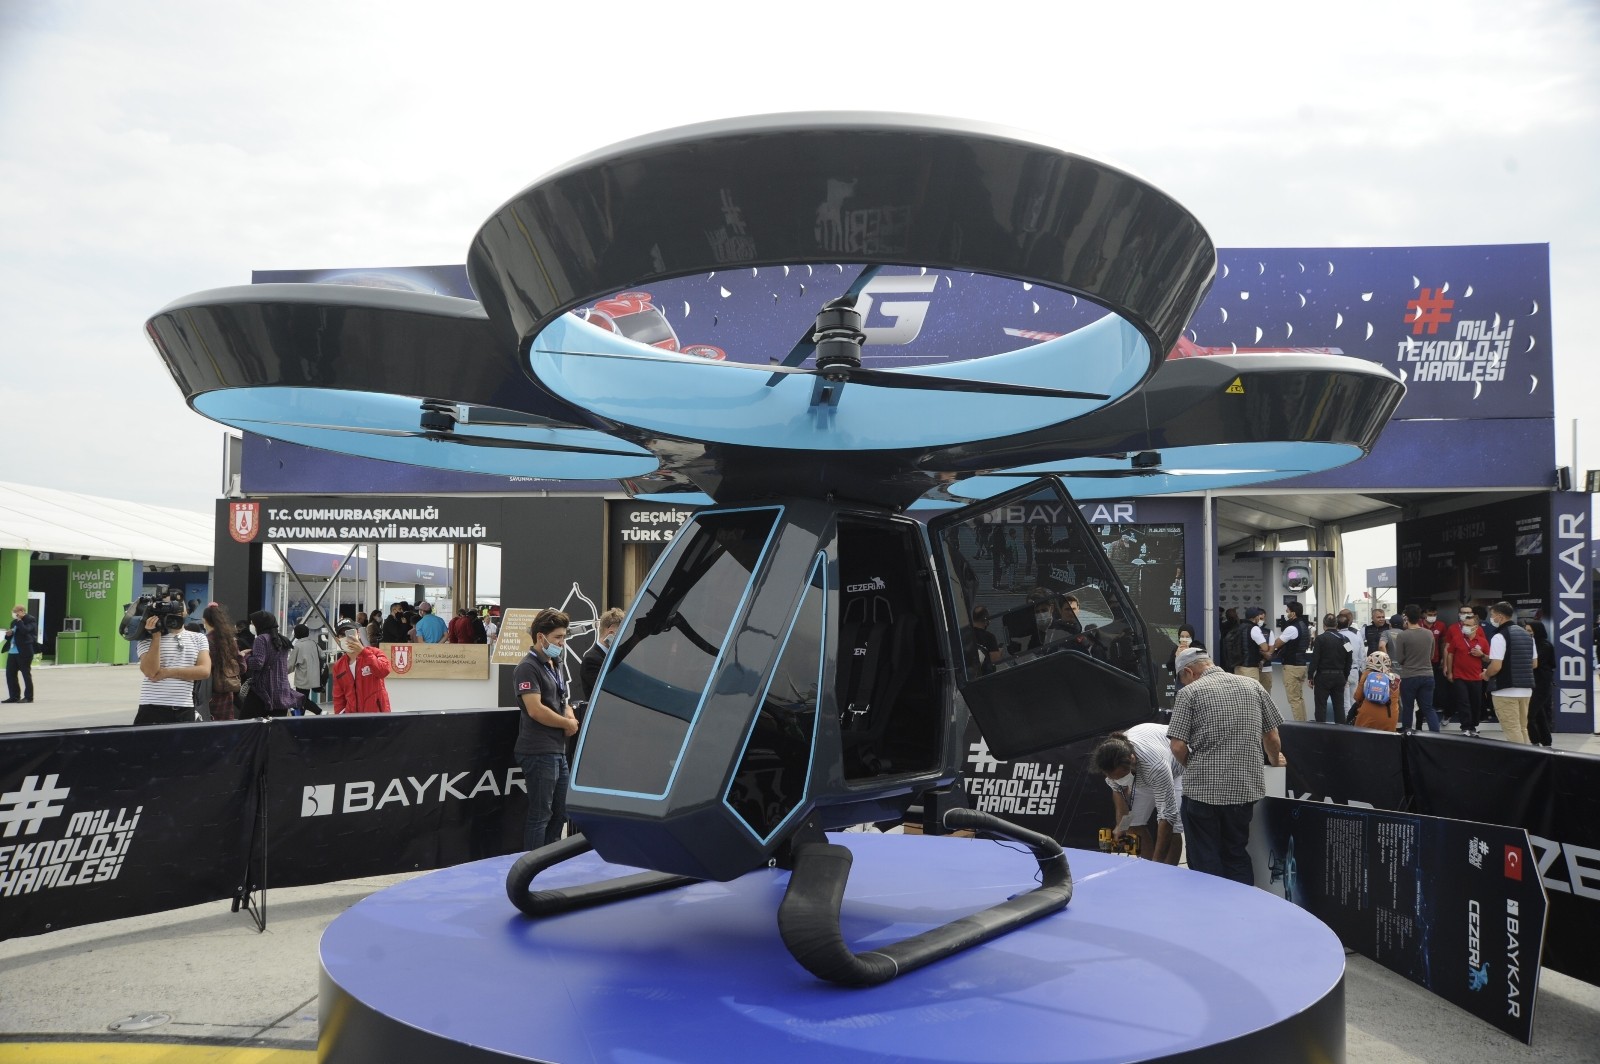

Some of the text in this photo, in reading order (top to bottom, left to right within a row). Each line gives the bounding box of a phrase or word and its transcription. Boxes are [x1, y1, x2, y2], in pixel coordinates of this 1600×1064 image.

[268, 505, 439, 523] T.C. CUMHURBAŞKANLIĞI
[1006, 503, 1135, 523] BAYAR
[267, 526, 338, 539] SAVUNMA
[399, 523, 487, 542] BAŞKANLIĞI
[621, 526, 662, 541] TÜRK
[103, 569, 115, 581] Et
[79, 580, 111, 589] Tasarla
[85, 588, 107, 599] Üret
[1558, 512, 1586, 681] BAYKAR
[342, 767, 528, 813] BAYKAR
[1506, 917, 1520, 1018] BAYKAR
